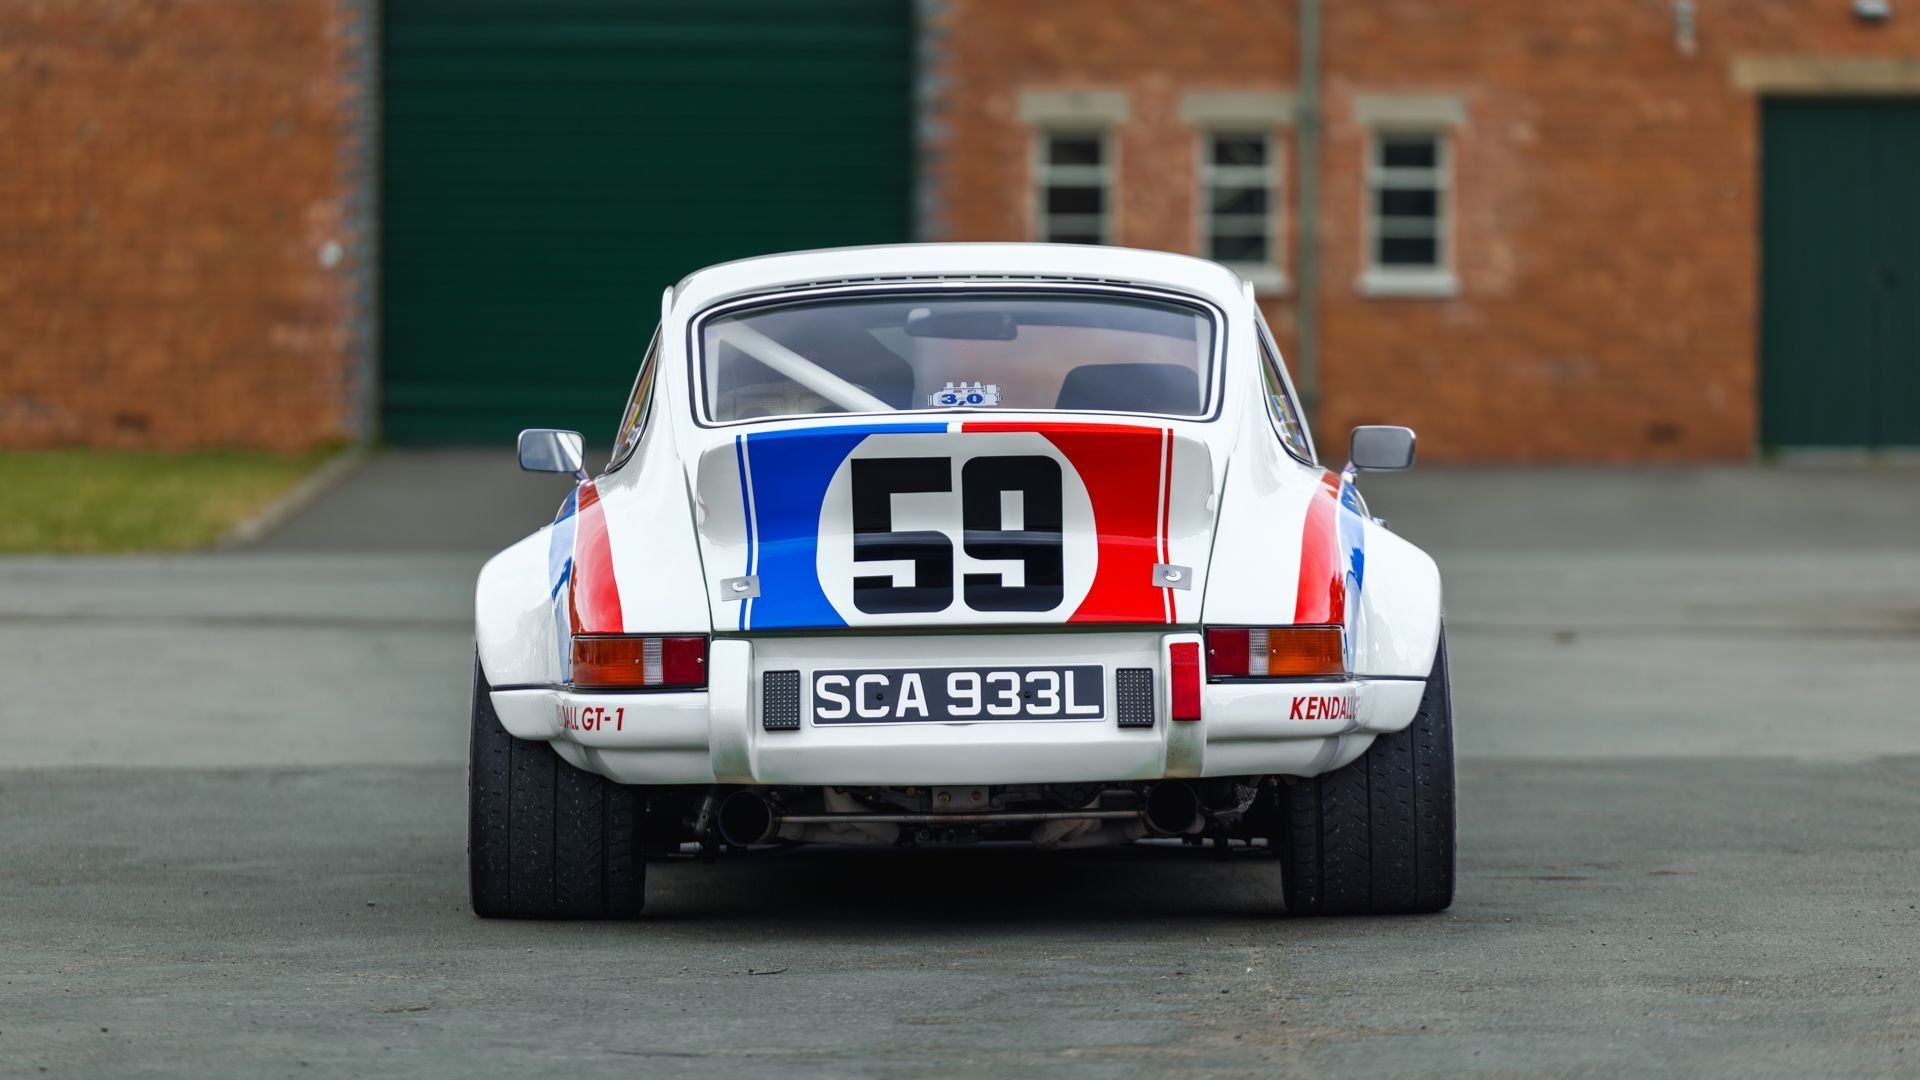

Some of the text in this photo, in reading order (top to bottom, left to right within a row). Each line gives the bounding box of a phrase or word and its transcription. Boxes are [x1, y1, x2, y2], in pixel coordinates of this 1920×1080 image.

[941, 393, 983, 406] 3,0
[851, 455, 1064, 614] 59
[816, 670, 1100, 719] SCA 933L
[582, 707, 624, 731] GT-1
